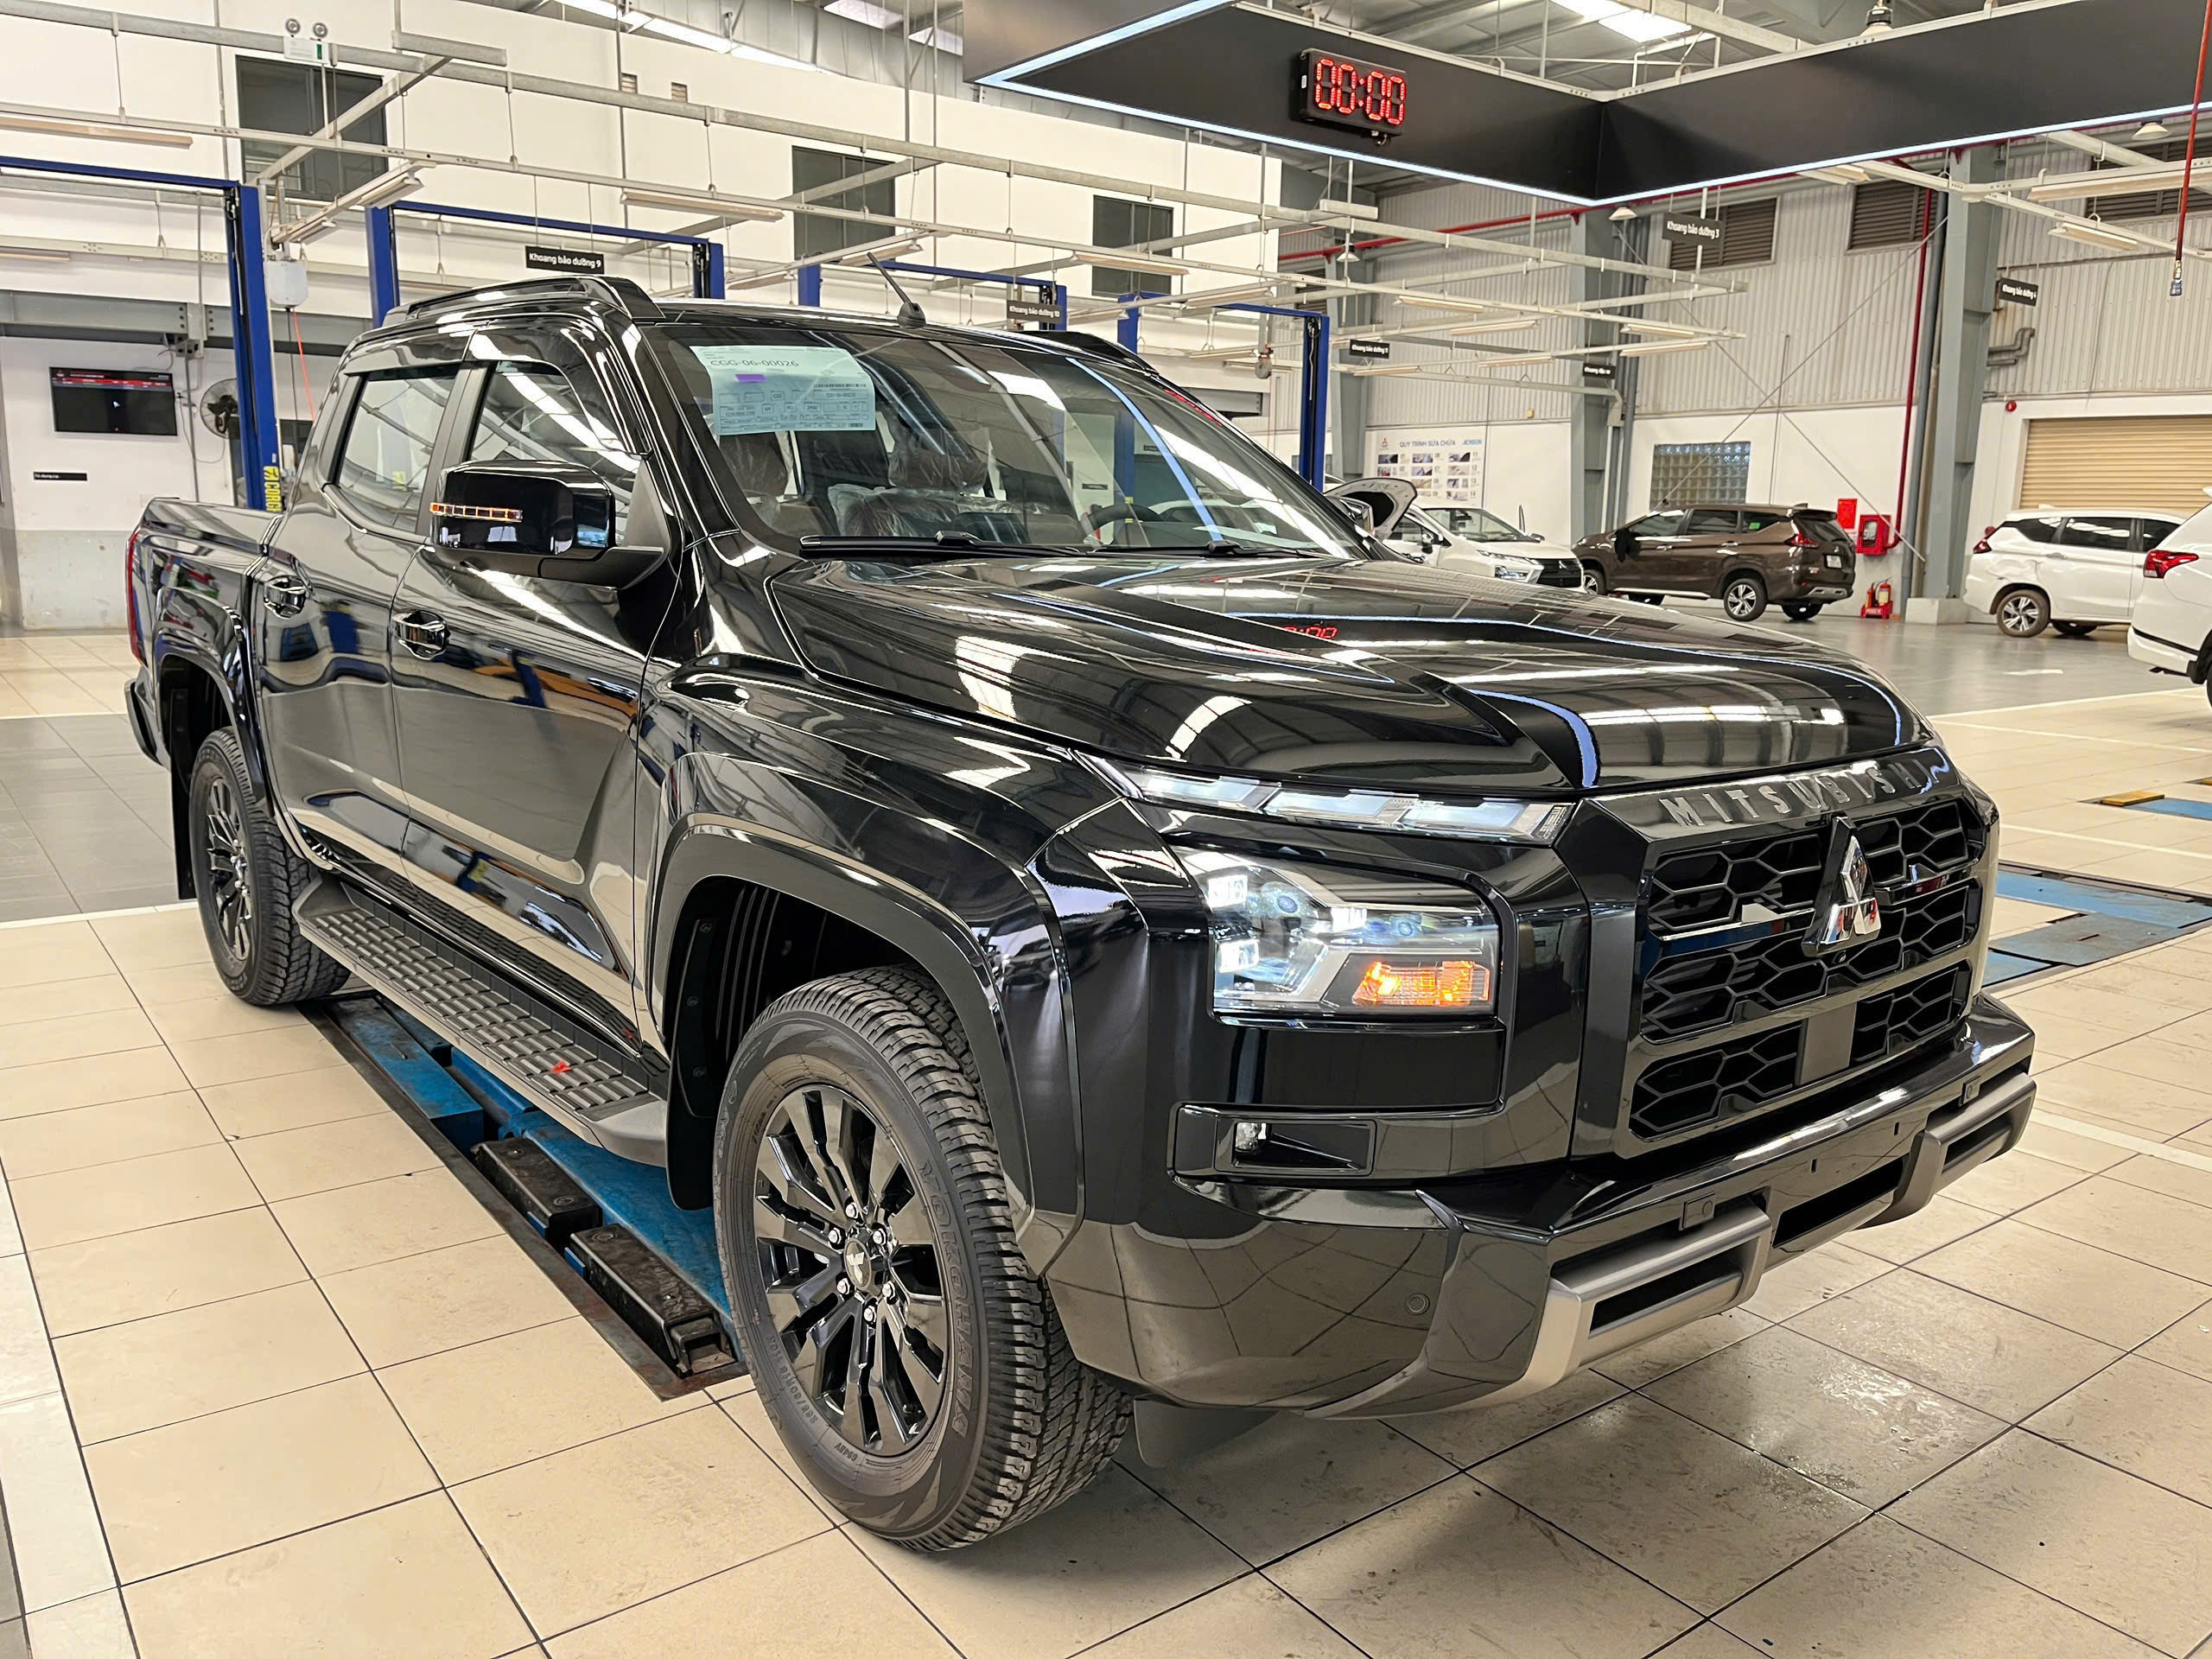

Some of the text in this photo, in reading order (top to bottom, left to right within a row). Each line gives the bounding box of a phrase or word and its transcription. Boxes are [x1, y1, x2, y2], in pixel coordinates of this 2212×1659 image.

[1315, 58, 1406, 125] 00:00
[1667, 220, 1687, 234] Khoang
[1715, 229, 1719, 238] 3
[529, 252, 601, 269] Khoang bảo dưỡng 9
[710, 359, 799, 368] CGG-06-00026
[1659, 758, 1941, 827] MITSUBISHI
[918, 1160, 974, 1439] YOKOHAMA
